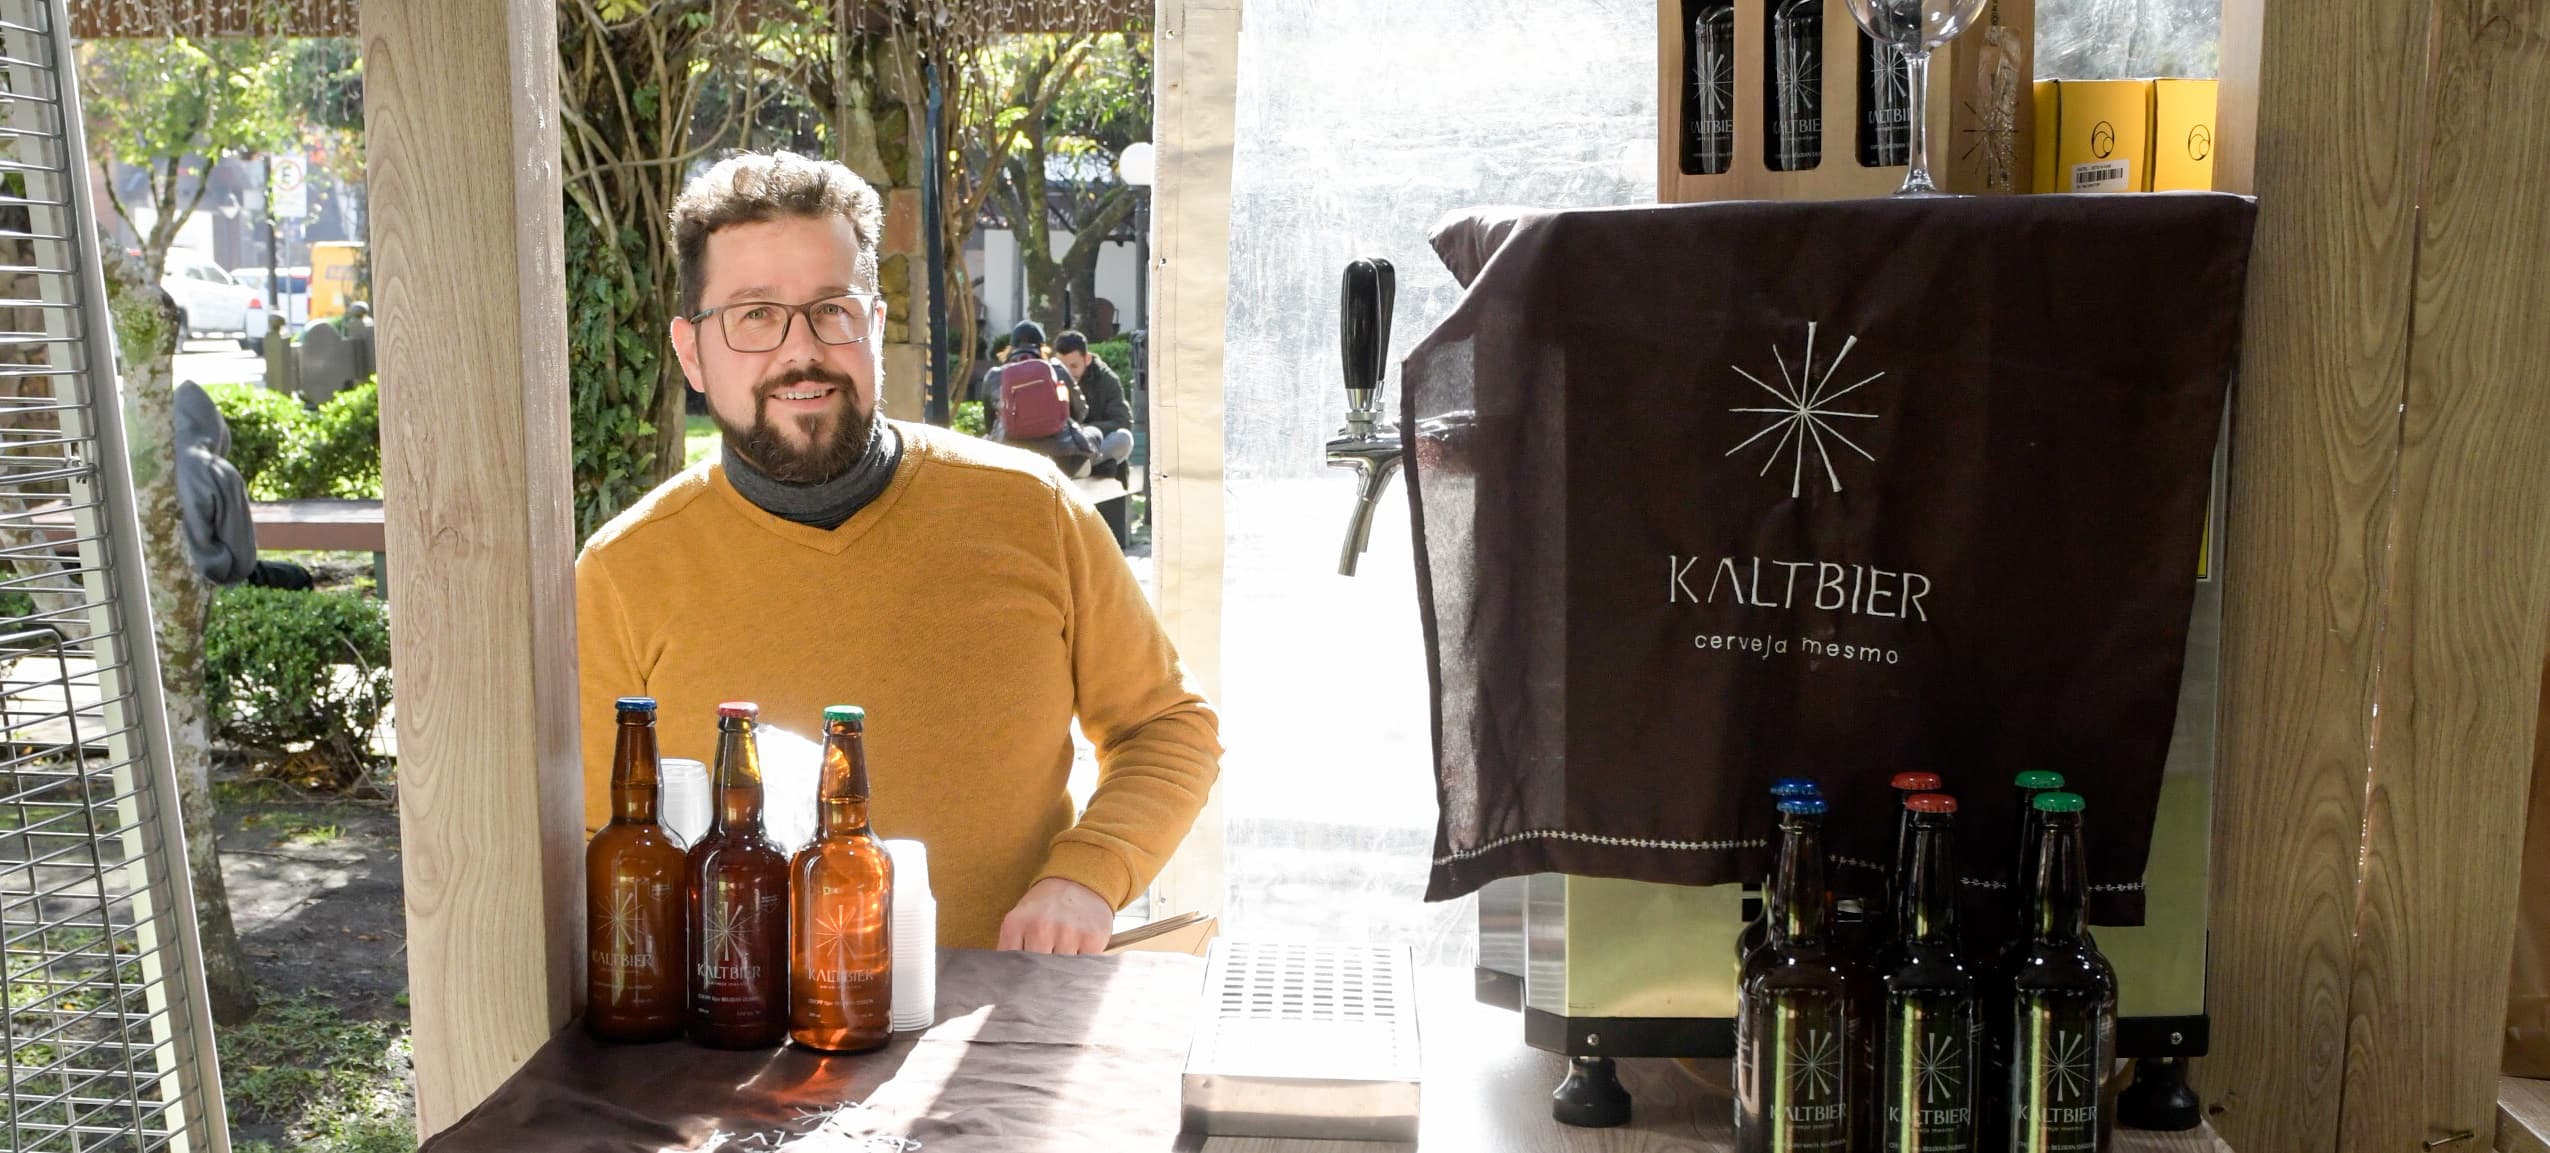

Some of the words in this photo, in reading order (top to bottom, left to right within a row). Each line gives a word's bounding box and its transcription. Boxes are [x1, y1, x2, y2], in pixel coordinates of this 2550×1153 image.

[1669, 555, 1931, 621] KALTBIER
[1694, 634, 1788, 660] cerveja
[1801, 636, 1899, 664] mesmo
[1889, 1106, 1970, 1126] KLTBIER
[2018, 1104, 2097, 1123] KLTBIER
